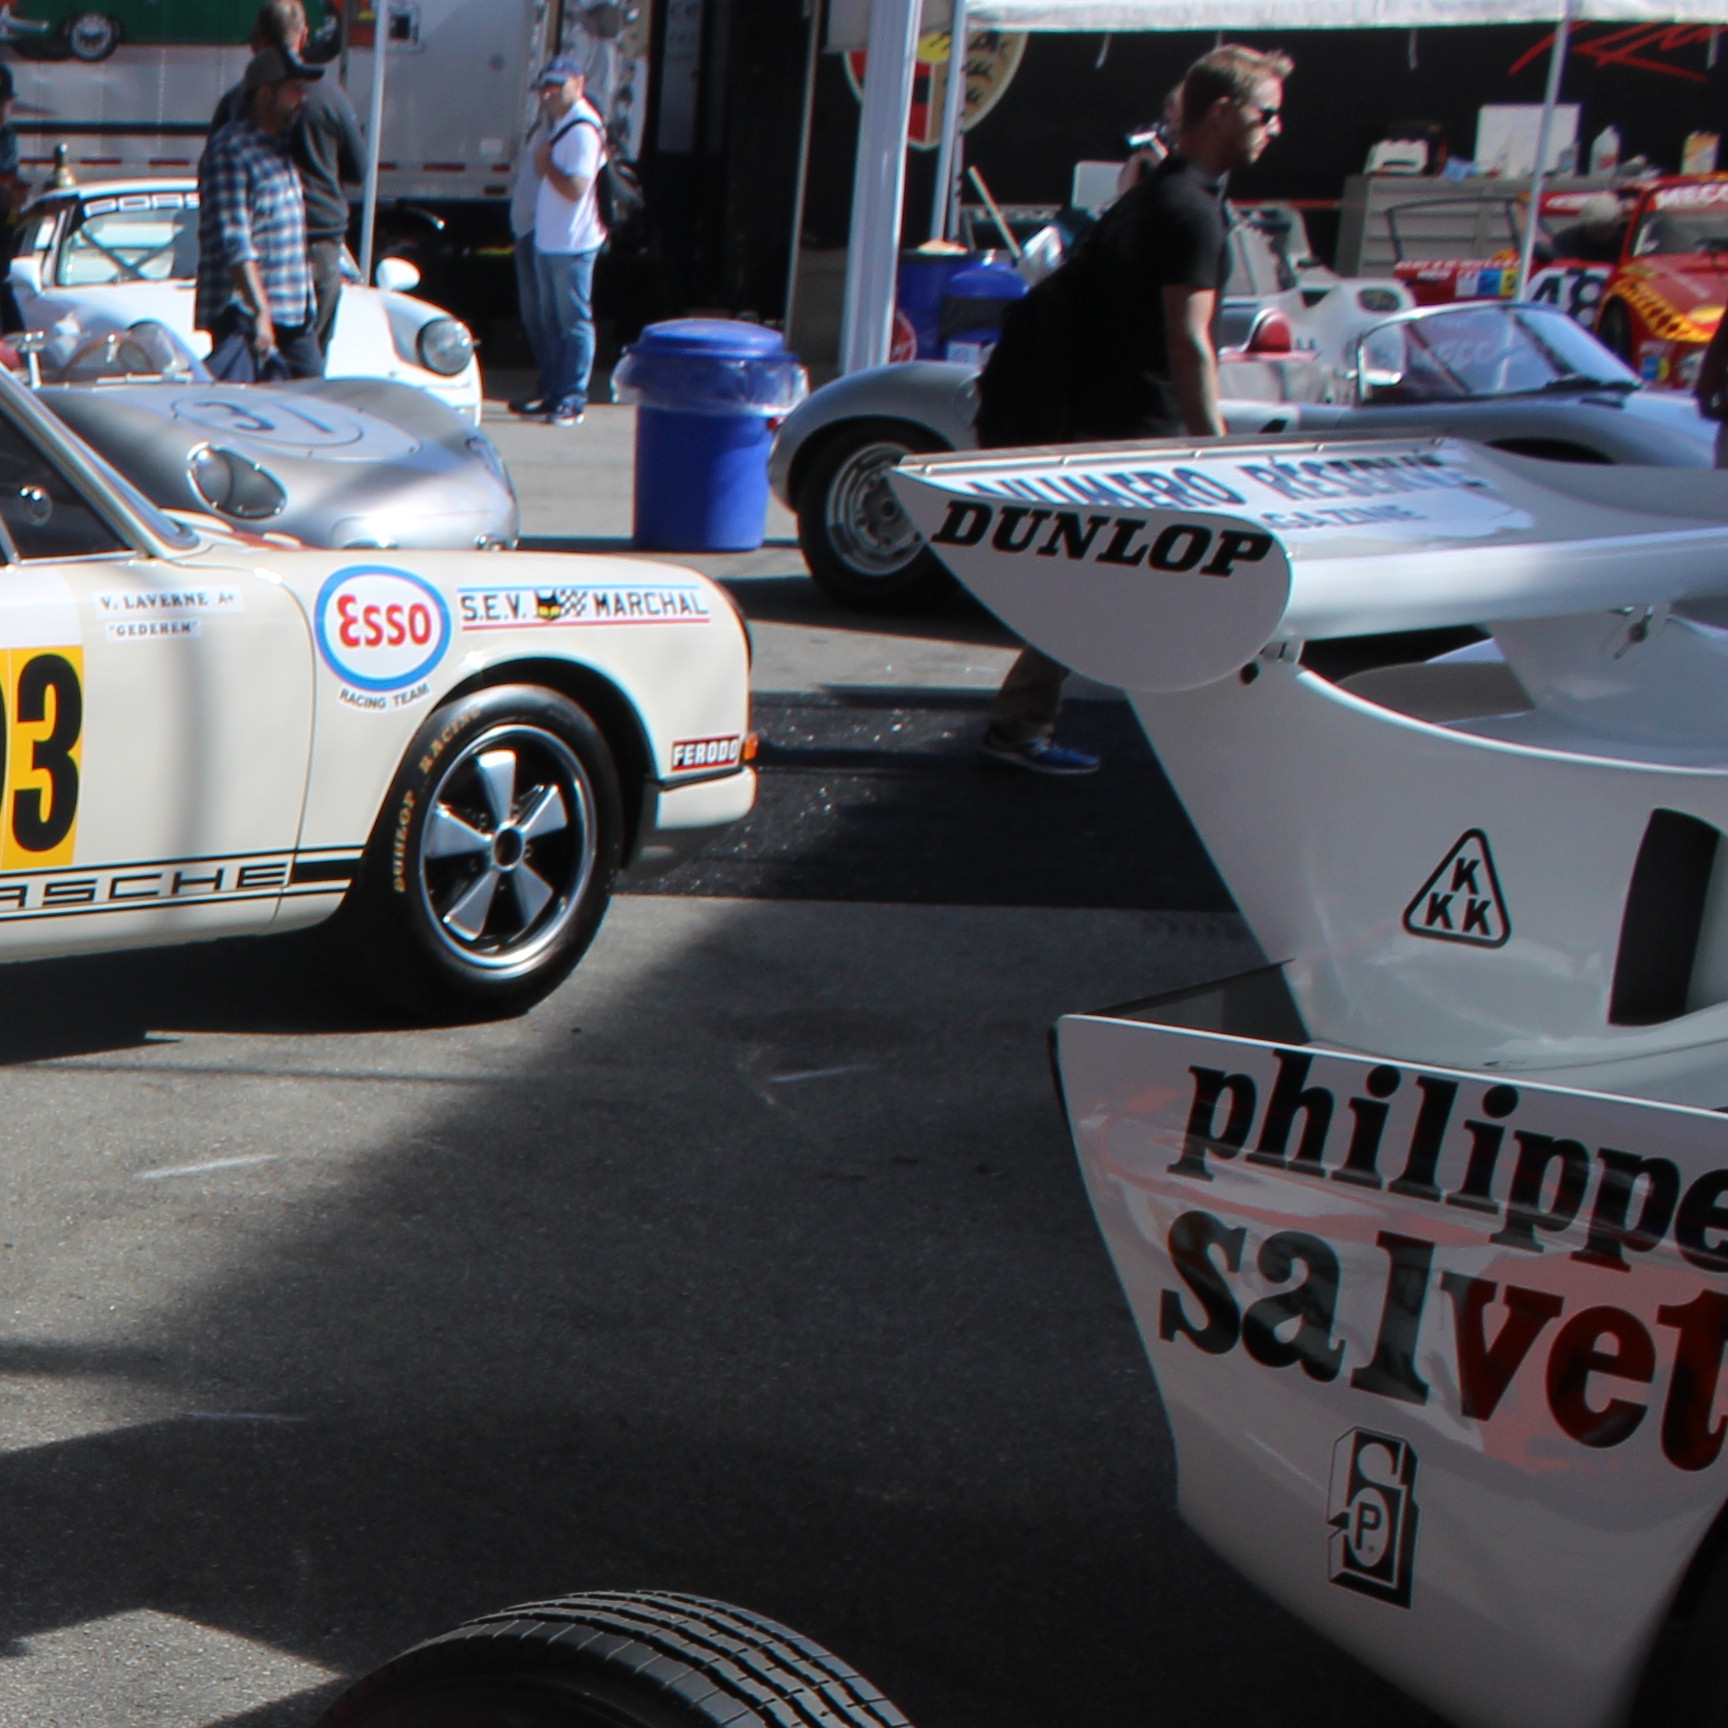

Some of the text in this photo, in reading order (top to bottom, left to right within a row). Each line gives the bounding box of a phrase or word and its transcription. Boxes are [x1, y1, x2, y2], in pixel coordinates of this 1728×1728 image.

[930, 499, 1274, 577] DUNLOP
[461, 587, 710, 621] S.E.V. MARCHAL
[339, 682, 430, 710] RACING TEAM
[673, 739, 740, 766] FERODO
[1167, 1048, 1728, 1273] philippe
